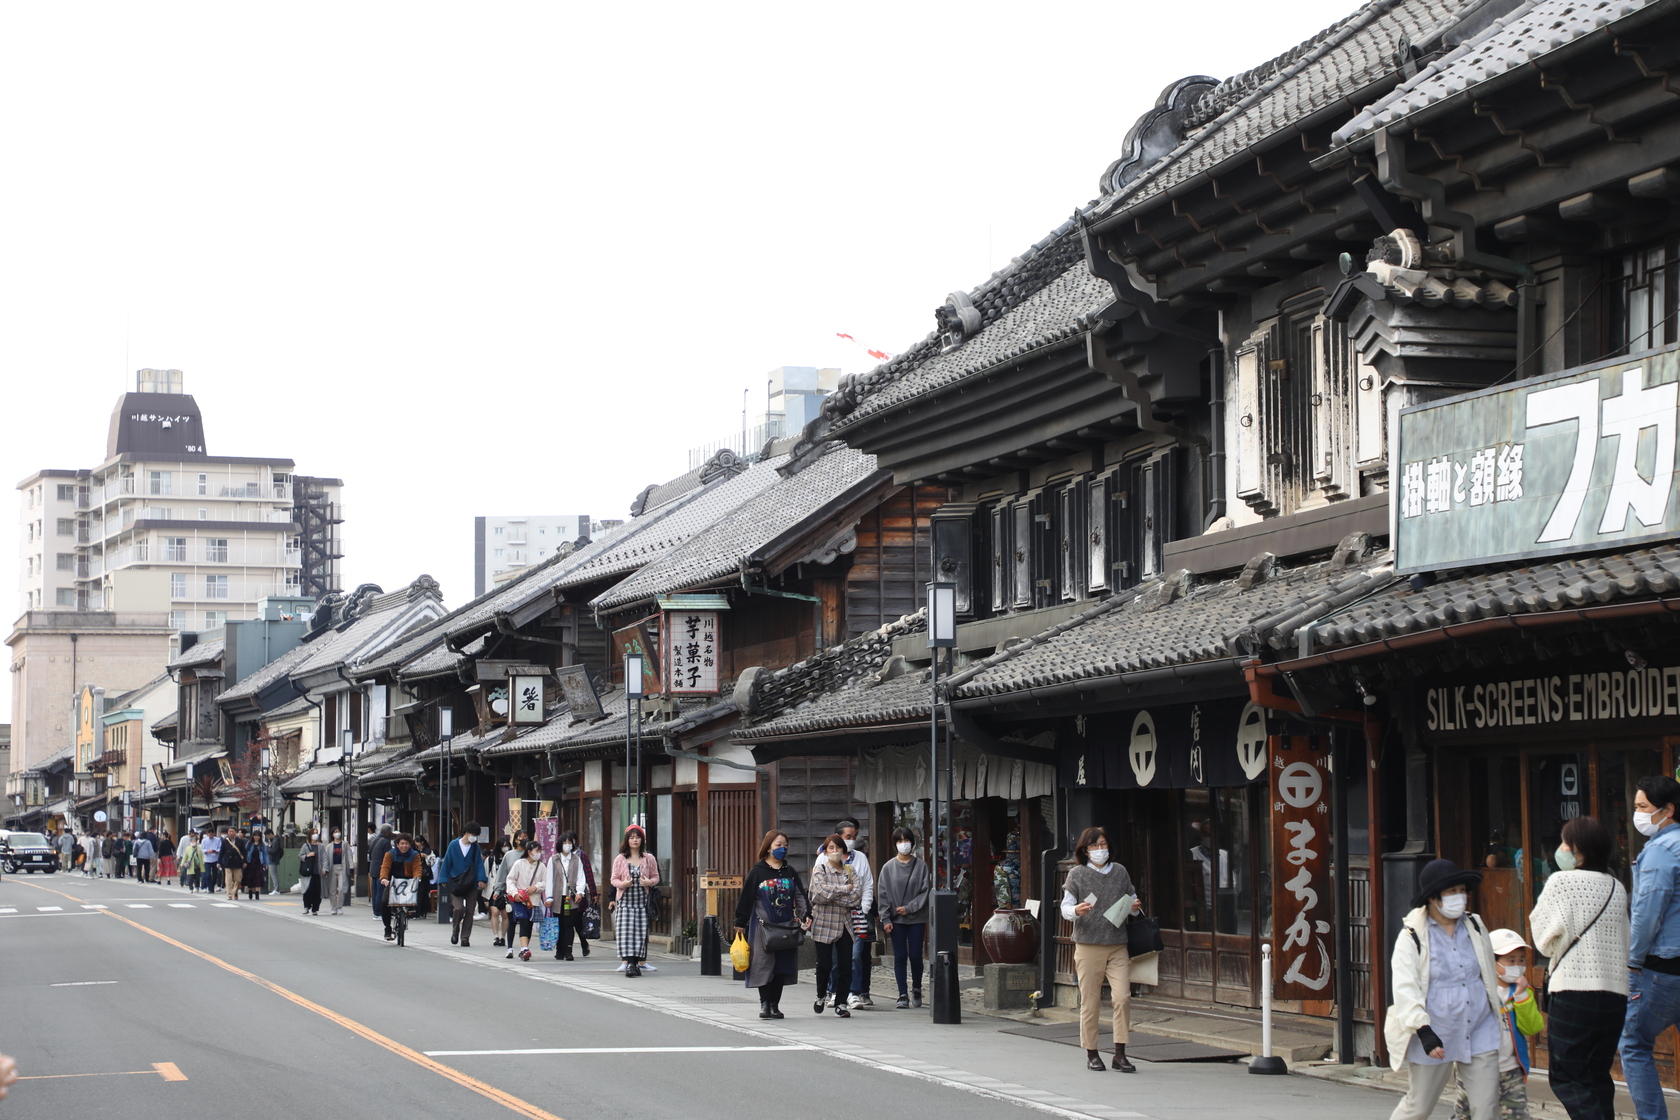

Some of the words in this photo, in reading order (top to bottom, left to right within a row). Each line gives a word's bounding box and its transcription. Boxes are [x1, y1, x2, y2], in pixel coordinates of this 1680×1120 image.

[131, 413, 190, 423] 川越サンハイツ
[1401, 442, 1525, 519] 掛軸と額縁
[684, 615, 702, 688] 芋菓子
[703, 617, 714, 668] 川越名物
[519, 685, 540, 711] 箸
[1282, 818, 1331, 991] まちかん
